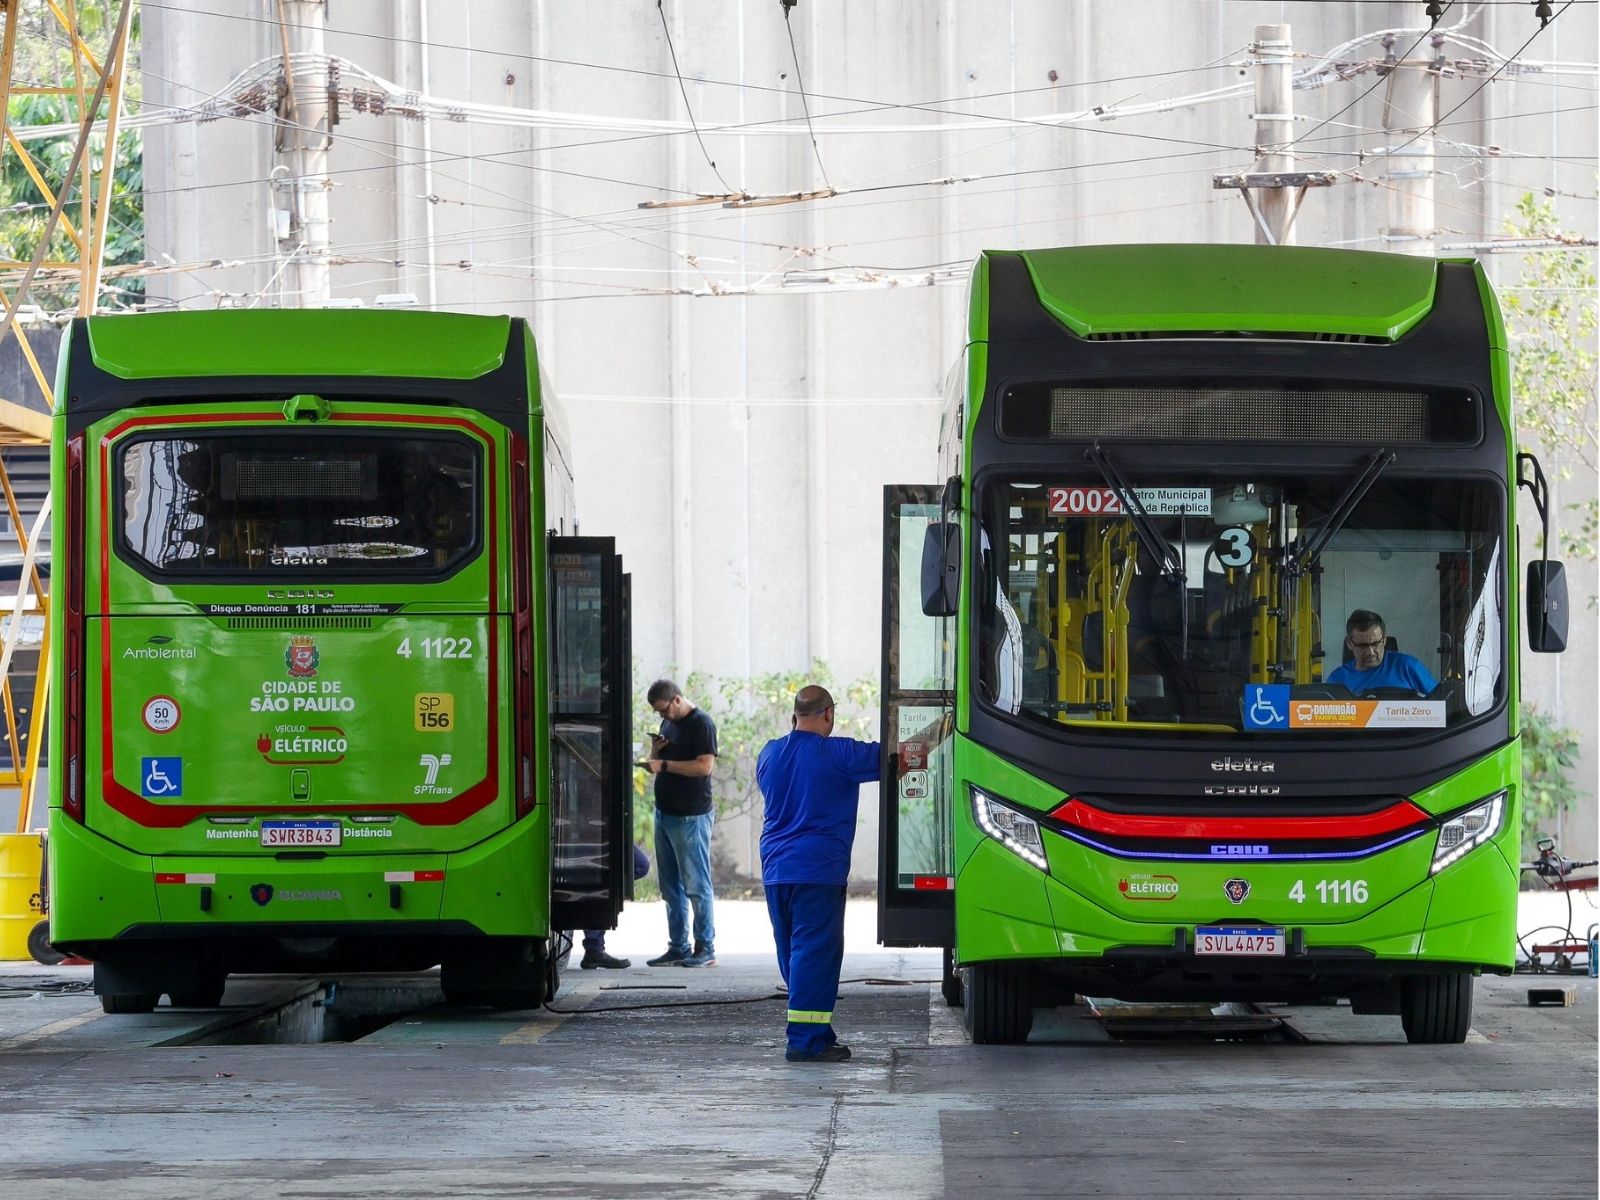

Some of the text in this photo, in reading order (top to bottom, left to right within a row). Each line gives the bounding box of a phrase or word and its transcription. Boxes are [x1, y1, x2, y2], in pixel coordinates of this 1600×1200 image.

[1052, 489, 1119, 512] 2002
[1122, 490, 1207, 502] Tatro Municipal
[1146, 503, 1158, 512] da
[1220, 528, 1253, 566] 3
[210, 604, 316, 614] Disque Denúncia 181
[123, 647, 197, 659] Ambiental
[397, 637, 472, 658] 4 1122
[262, 681, 341, 694] CIDADE DE
[250, 694, 355, 712] SÃO PAULO
[419, 696, 441, 711] SP
[1313, 703, 1357, 715] DOMINGÃO
[154, 707, 169, 719] 50
[1385, 707, 1432, 716] Tarifa Zero
[419, 712, 450, 728] 156
[903, 714, 927, 722] Tarifa
[275, 723, 305, 733] VEÍCULO
[900, 727, 911, 736] R$
[275, 735, 348, 753] ELÉTRICO
[1211, 757, 1274, 772] eletra
[414, 785, 453, 795] SPTrans
[206, 827, 392, 839] Mantenha Distância
[269, 829, 333, 843] SWR3B43
[1130, 881, 1179, 893] ELÉTRICO
[1288, 879, 1369, 904] 4 1116
[1204, 936, 1275, 952] SVL4A75
